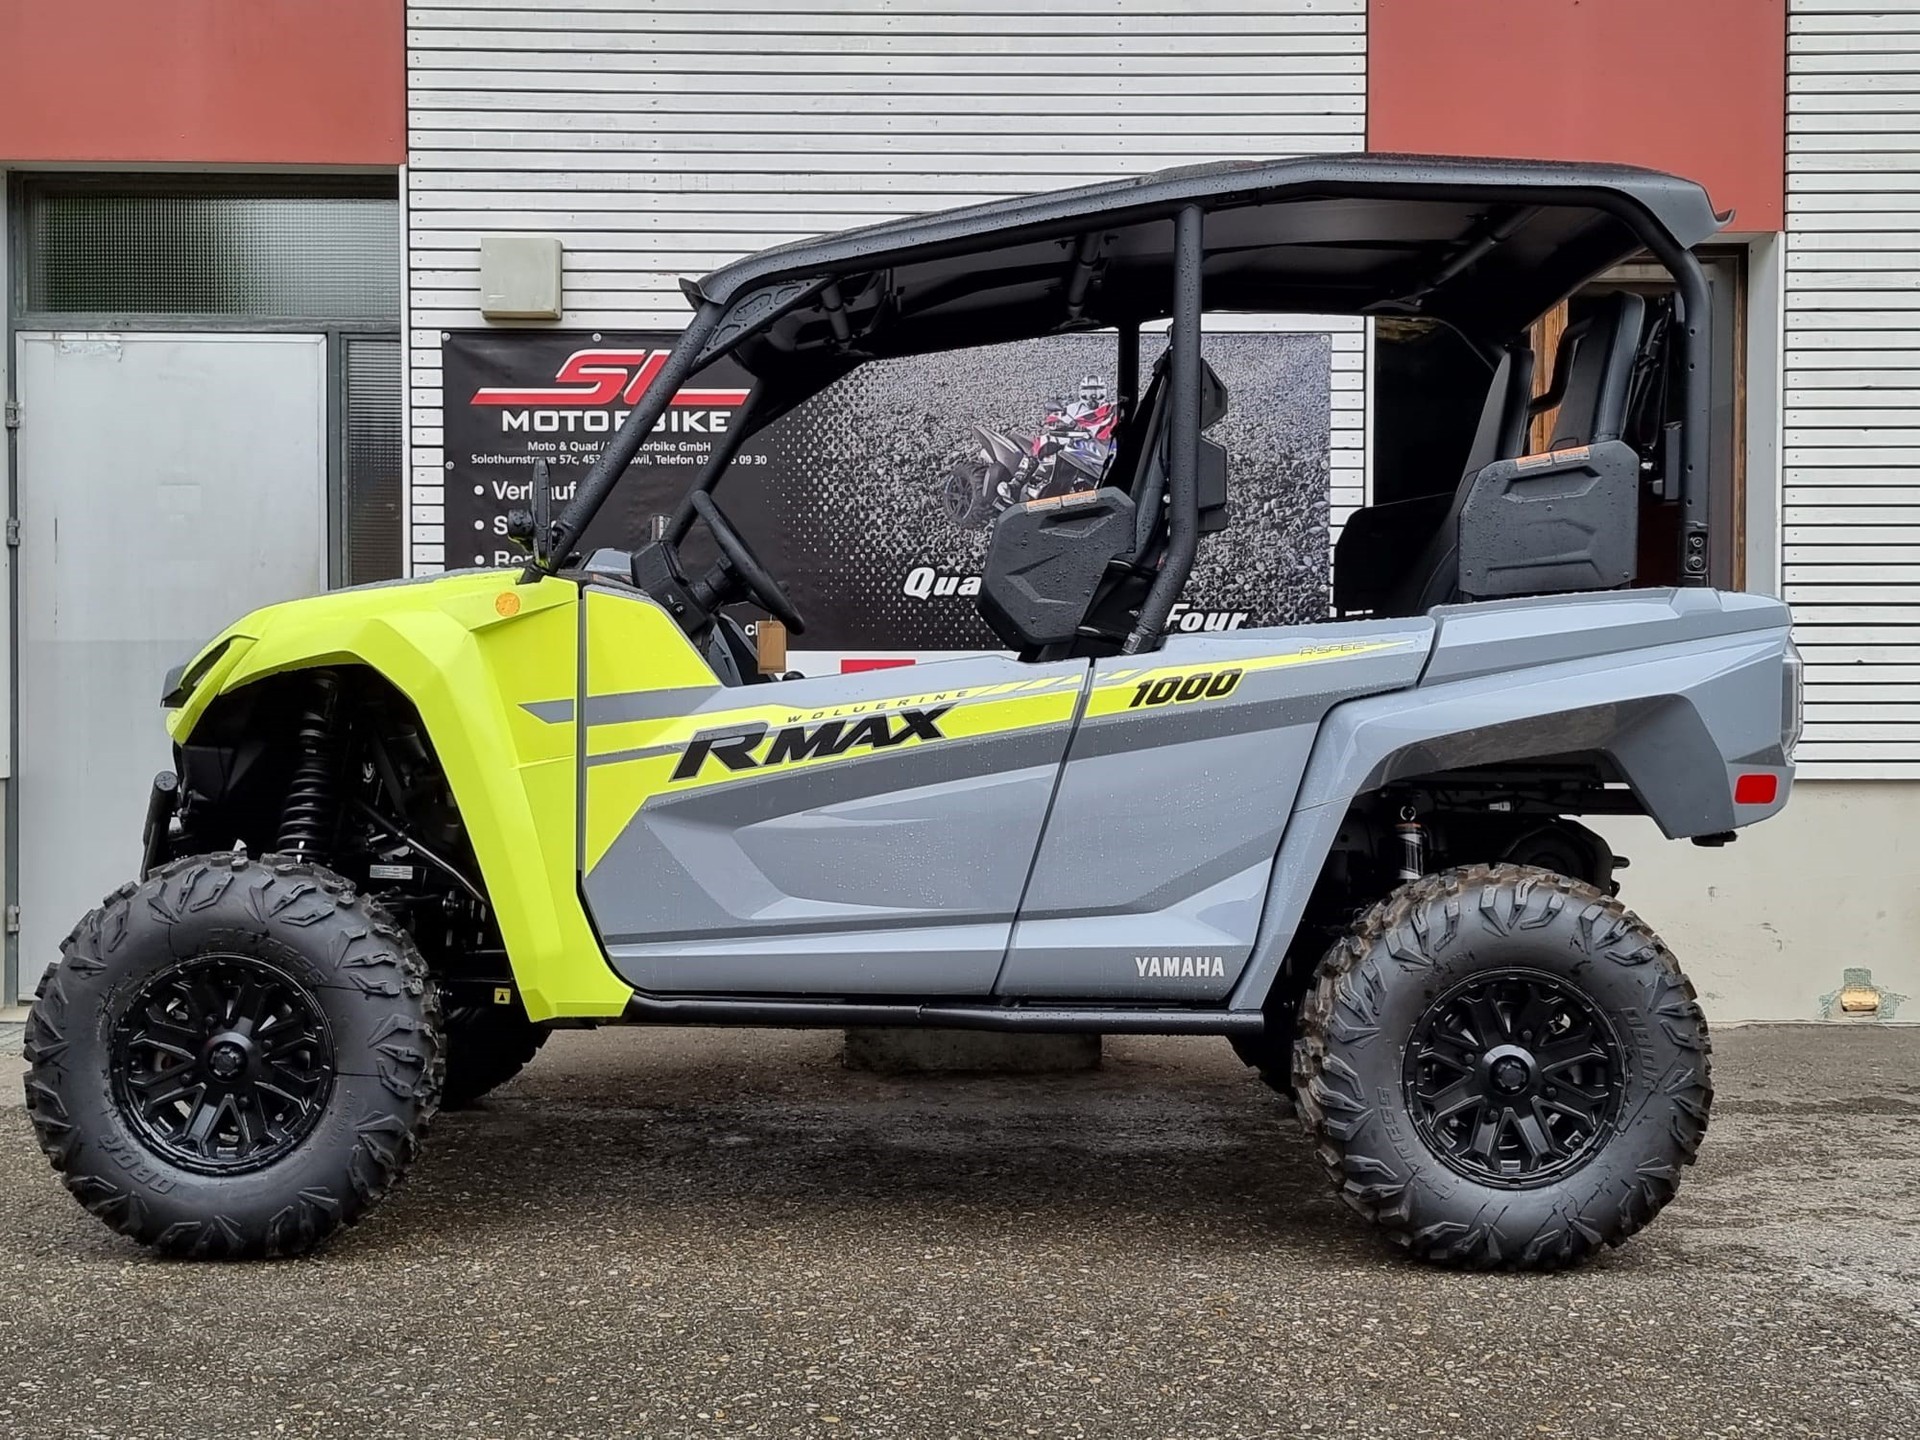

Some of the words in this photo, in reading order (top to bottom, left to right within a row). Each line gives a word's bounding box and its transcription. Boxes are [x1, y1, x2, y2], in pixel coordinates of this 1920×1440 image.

[528, 441, 556, 451] Moto
[559, 441, 567, 451] &
[570, 441, 599, 453] Quad
[679, 441, 711, 452] GmbH
[560, 455, 580, 466] 57c,
[655, 455, 694, 465] Telefon
[739, 455, 752, 465] 09
[754, 455, 768, 465] 30
[1128, 668, 1243, 708] 1000
[668, 701, 960, 783] RMAX
[1135, 956, 1225, 977] YAMAHA
